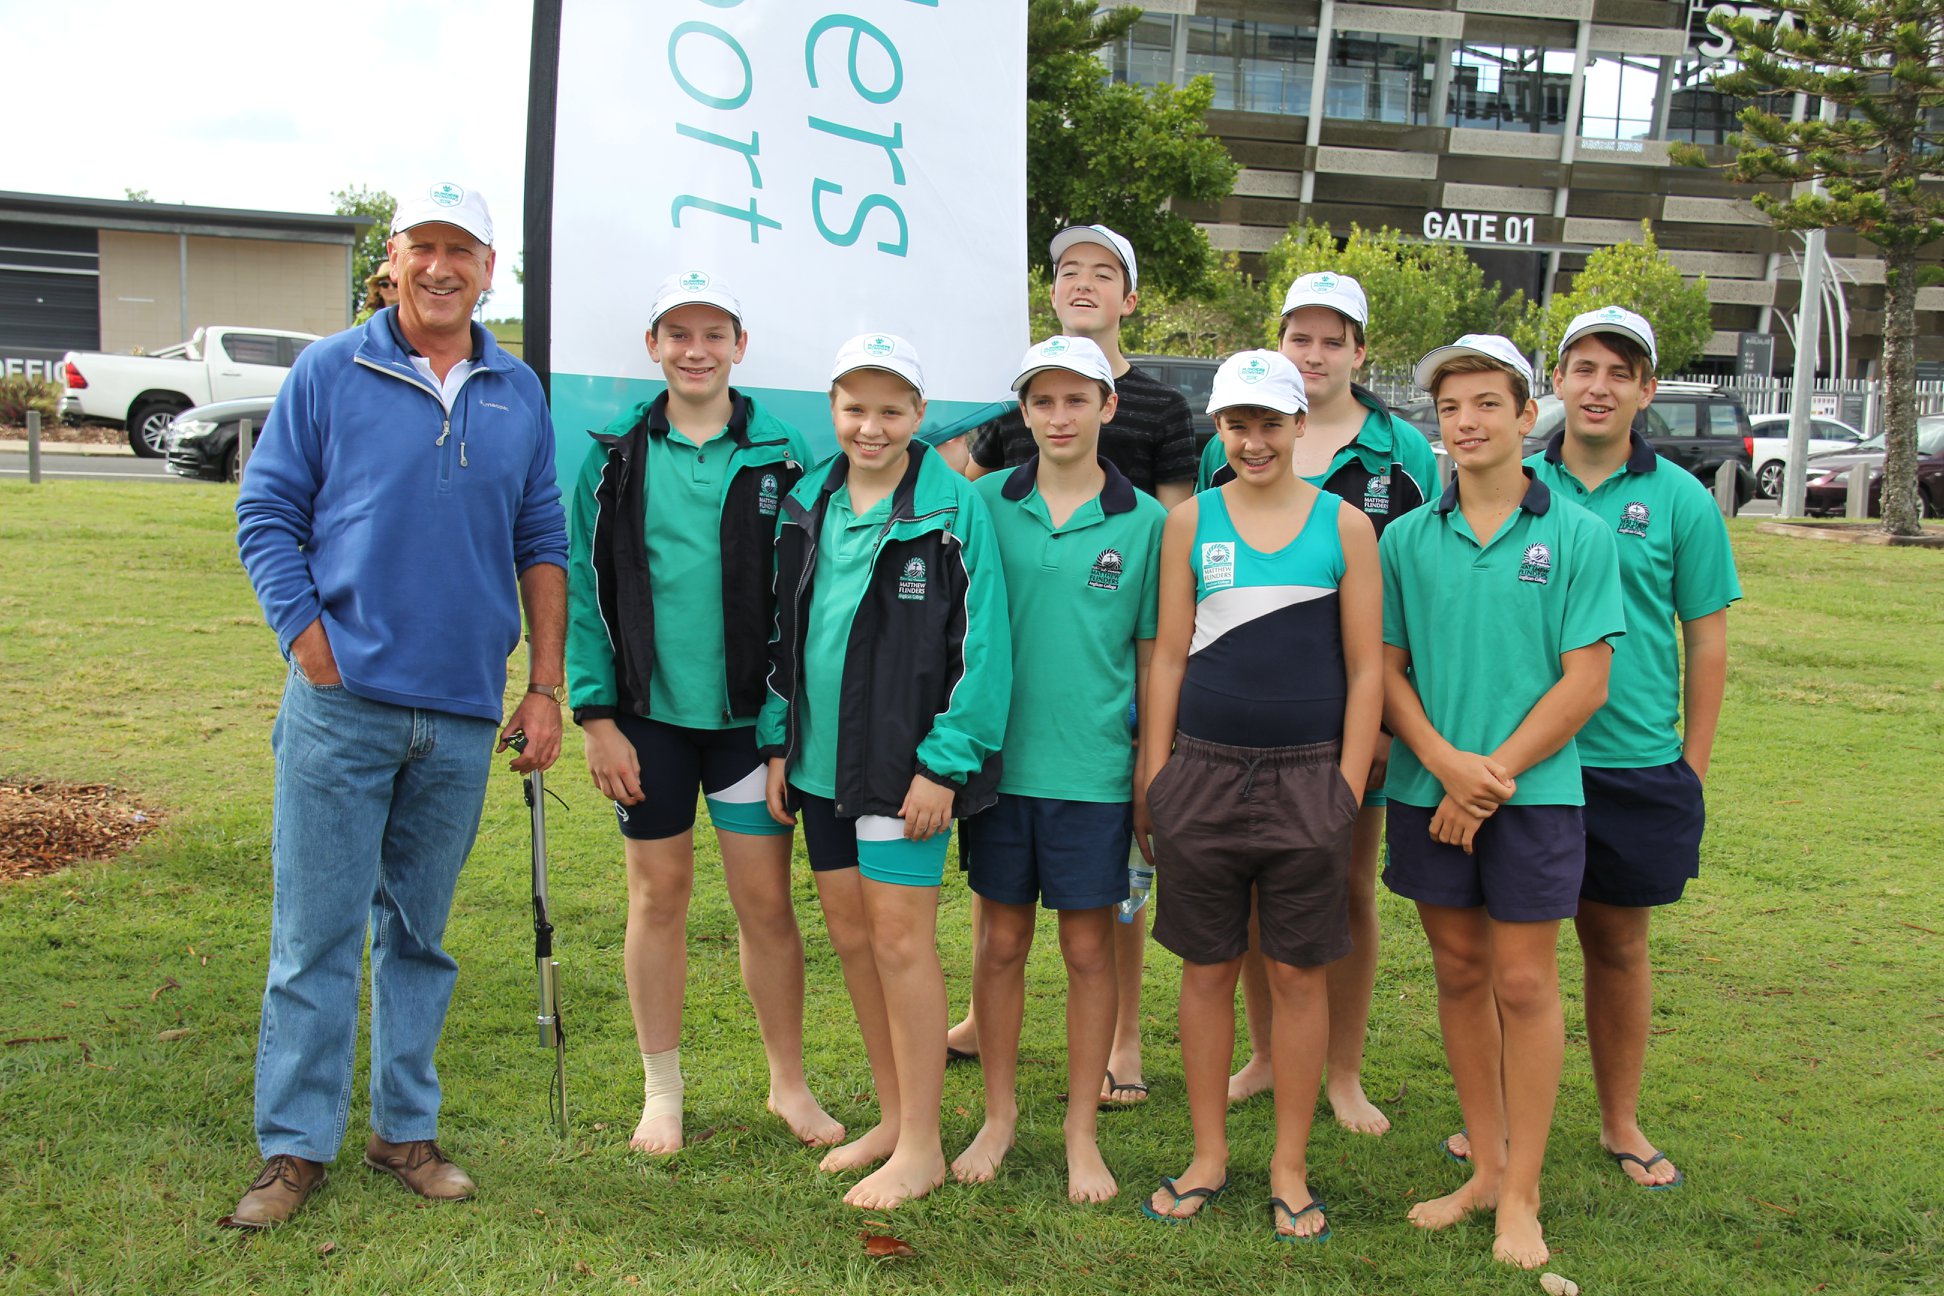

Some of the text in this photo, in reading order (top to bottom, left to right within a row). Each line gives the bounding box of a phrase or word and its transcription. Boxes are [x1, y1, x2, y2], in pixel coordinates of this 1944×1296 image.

[667, 0, 782, 244] ort
[805, 0, 938, 258] ers
[1423, 211, 1535, 245] GATE 01
[1364, 502, 1389, 510] FLINDERS
[1091, 568, 1121, 579] MATTHEW
[1204, 567, 1232, 575] MATTHEW
[1089, 574, 1119, 584] FLINDERS
[1204, 572, 1232, 581] FLINDERS
